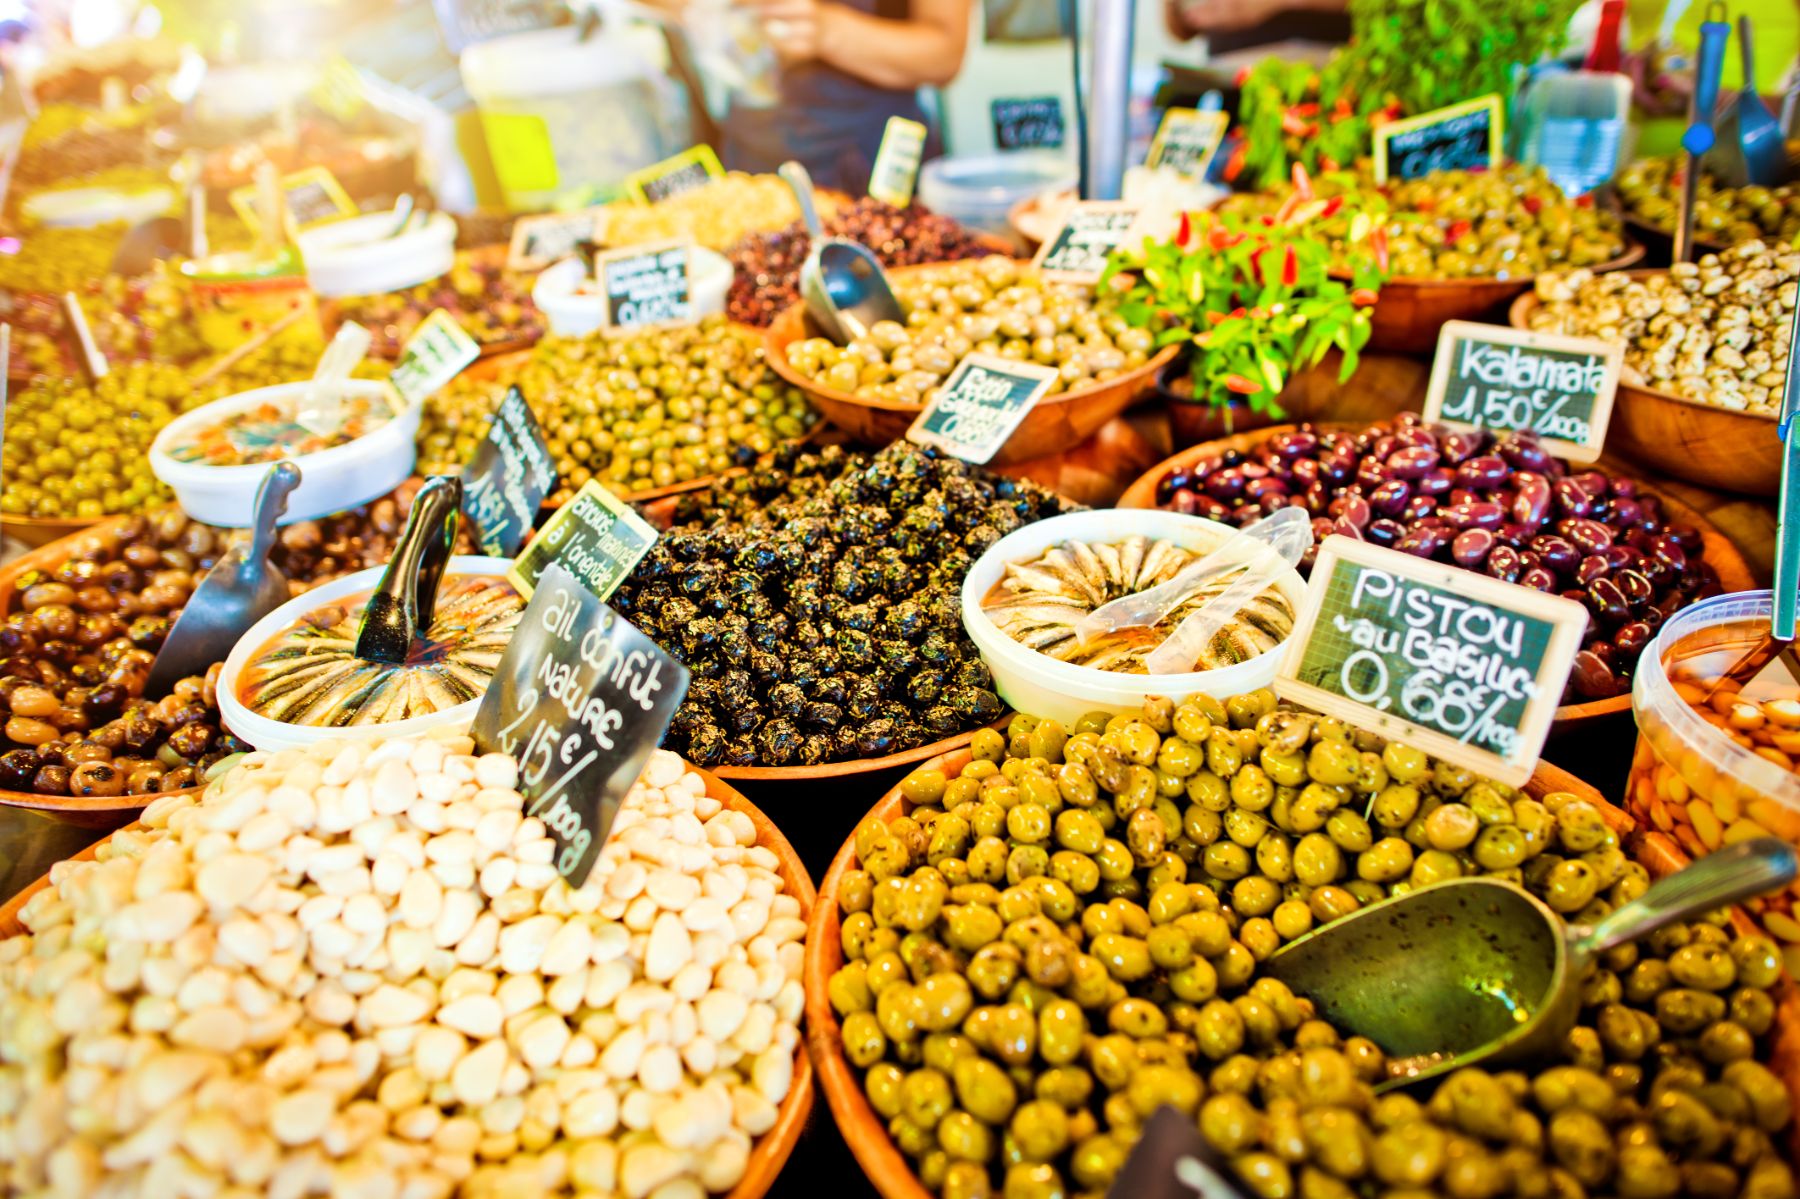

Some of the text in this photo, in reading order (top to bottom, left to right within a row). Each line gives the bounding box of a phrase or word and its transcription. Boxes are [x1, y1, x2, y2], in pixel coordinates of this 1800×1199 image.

[1460, 338, 1609, 394] Kalamata
[547, 519, 570, 545] à
[542, 588, 662, 711] ail confit
